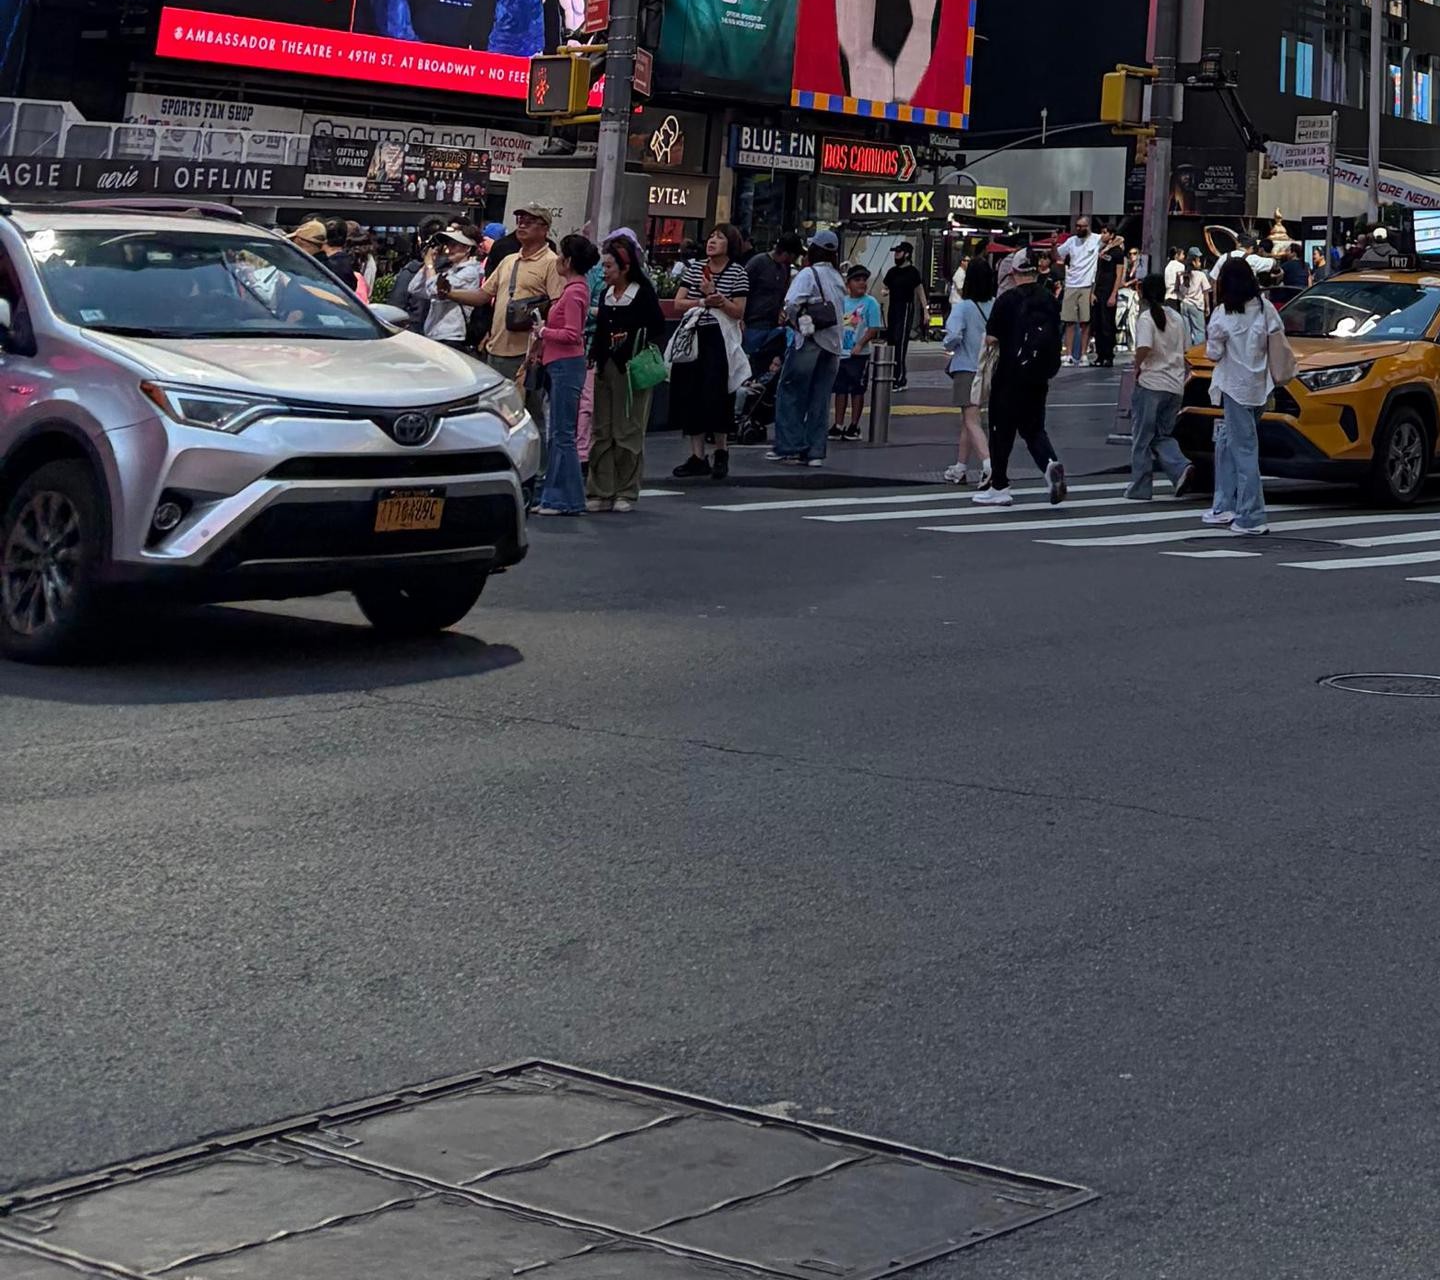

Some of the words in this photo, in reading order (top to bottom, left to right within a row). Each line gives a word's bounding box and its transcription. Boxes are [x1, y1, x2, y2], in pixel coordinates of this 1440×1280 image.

[186, 26, 277, 53] AMBASSADOR
[281, 37, 333, 61] THEATRE
[347, 48, 376, 66] 49TH
[380, 52, 396, 68] ST.
[400, 54, 415, 70] AT
[416, 57, 477, 77] BROADWAY
[488, 66, 506, 82] NO
[161, 98, 202, 118] SPORTS
[203, 101, 225, 120] FAN
[228, 104, 254, 122] SHOP
[490, 136, 532, 152] DISCOUNT
[741, 126, 782, 152] BLUE
[789, 132, 815, 156] FIN
[494, 150, 517, 163] GIFTS
[824, 143, 848, 170] DOS
[850, 148, 898, 175] CAMINOS
[97, 165, 138, 189] aerie
[174, 167, 273, 190] OFFLINE
[851, 191, 934, 214] KLIKTIX
[949, 194, 976, 210] TICKET
[977, 198, 1007, 211] CENTER
[1406, 190, 1440, 210] NEON
